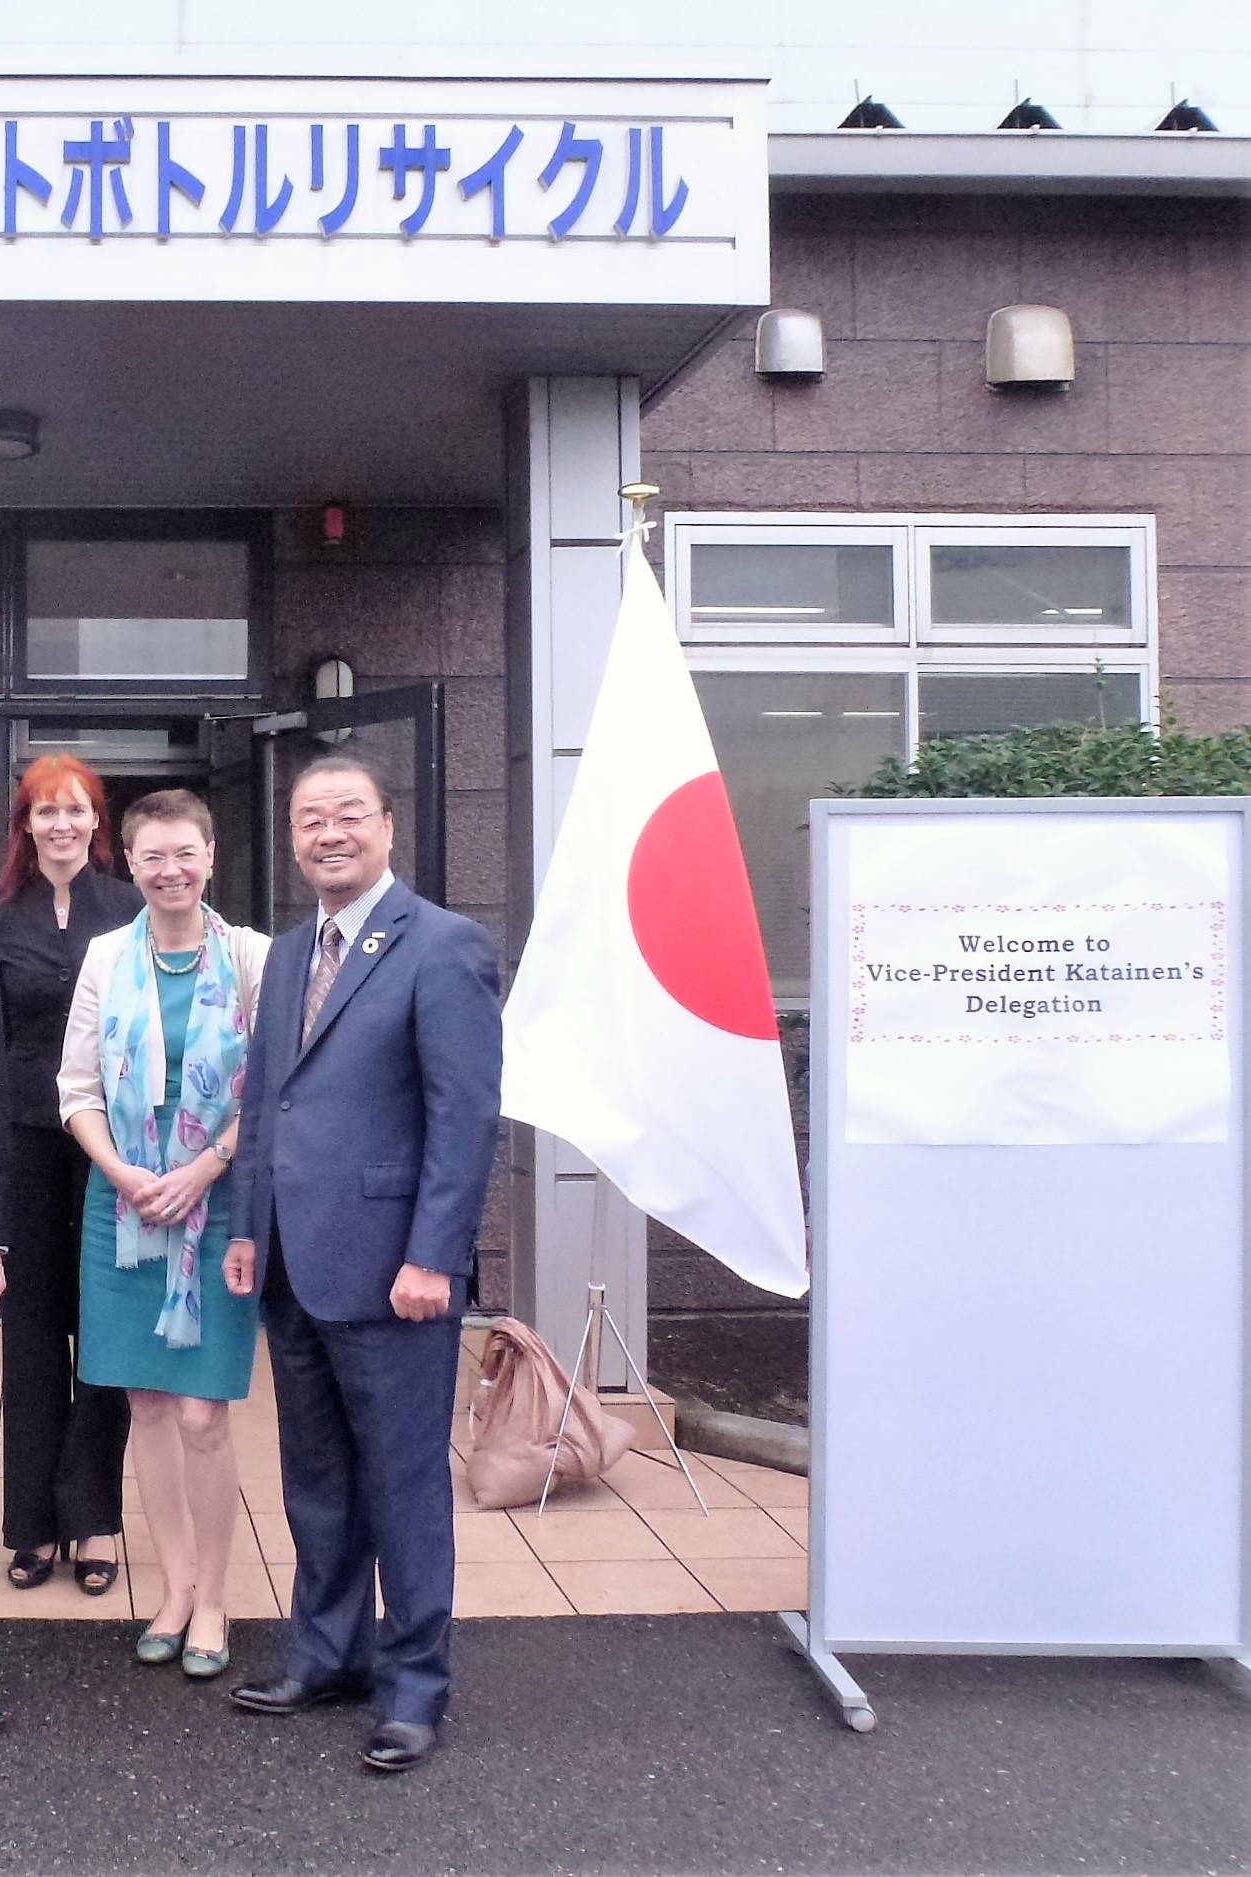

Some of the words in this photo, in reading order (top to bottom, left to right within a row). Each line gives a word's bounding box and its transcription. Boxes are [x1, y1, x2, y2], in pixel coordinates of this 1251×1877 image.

[959, 935, 1074, 952] Welcome
[1085, 936, 1111, 953] to
[867, 964, 1055, 982] Vice-President
[1065, 961, 1204, 981] Katainen's
[965, 995, 1103, 1019] Delegation
